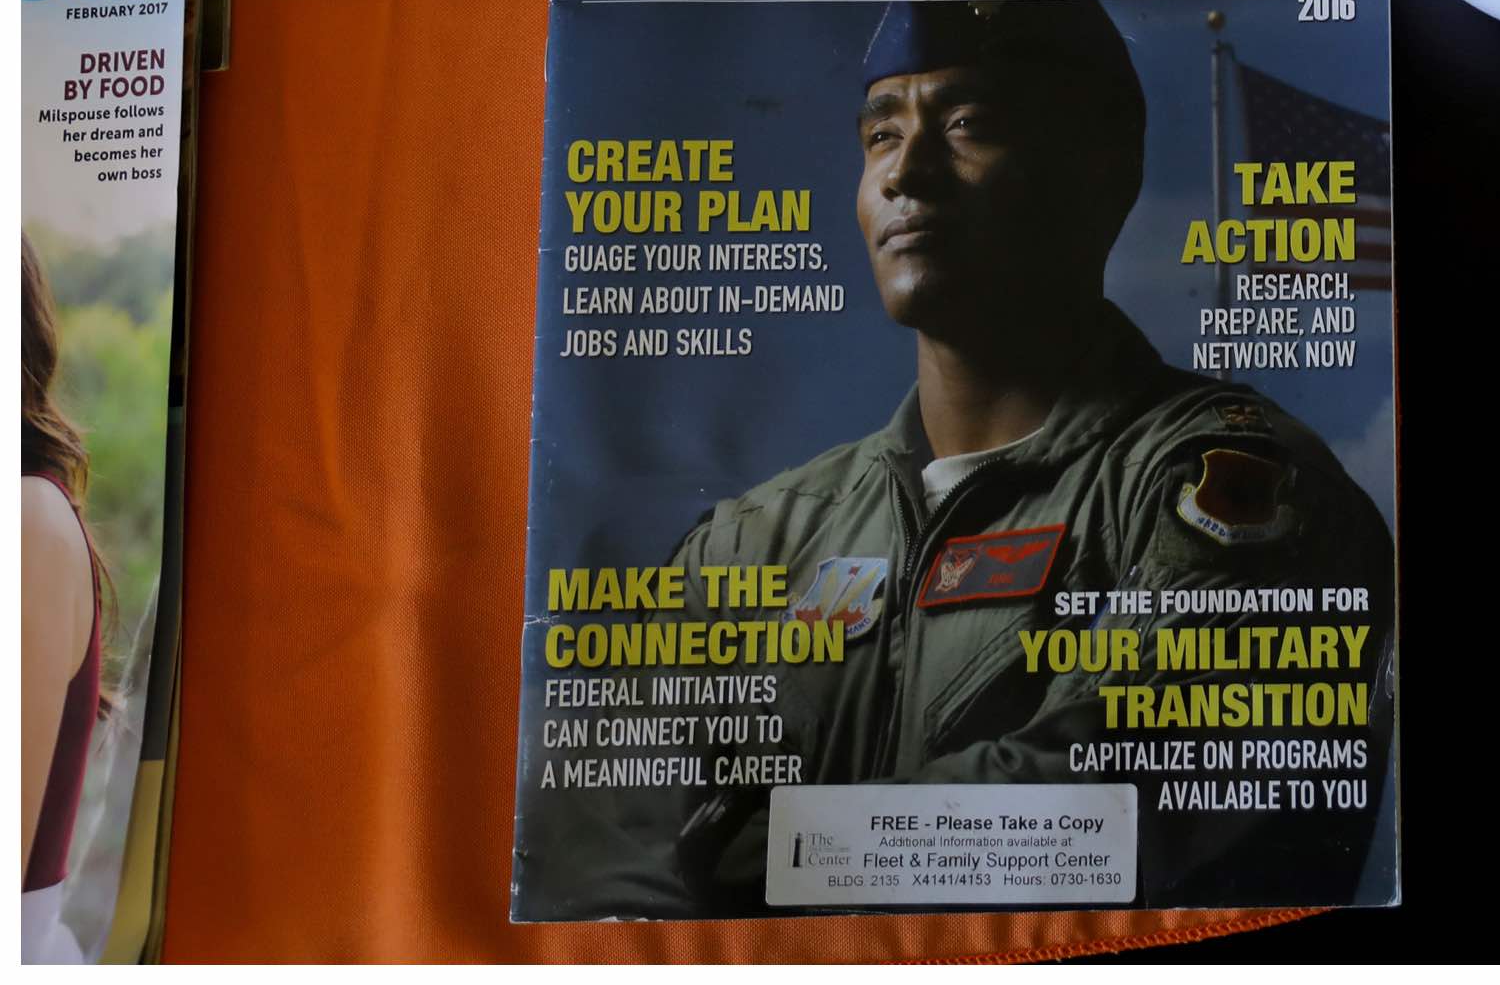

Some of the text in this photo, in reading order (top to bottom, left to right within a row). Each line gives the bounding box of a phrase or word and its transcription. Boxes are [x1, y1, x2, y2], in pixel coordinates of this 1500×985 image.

[66, 2, 168, 19] FEBRUARY 2017
[80, 48, 165, 74] DRIVEN
[64, 75, 165, 100] BY FOOD
[39, 103, 164, 124] Milspouse follows
[567, 139, 734, 183] CREATE
[1234, 161, 1356, 205] TAKE
[565, 189, 811, 233] YOUR PLAN
[1181, 218, 1356, 263] ACTION
[565, 243, 828, 272] GUAGE YOUR INTERESTS,
[1236, 273, 1355, 301] RESEARCH,
[548, 565, 788, 611] MAKE THE
[545, 620, 844, 668] CONNECTION
[1018, 625, 1371, 673] YOUR MILITARY
[545, 675, 777, 707] FEDERAL INITIATIVES
[1099, 683, 1369, 729] TRANSITION
[871, 815, 1104, 834] FREE Please Take a Copy
[879, 836, 1072, 848] Additional Information available at
[863, 852, 1110, 871] Fleet & Family Support Center
[871, 872, 1121, 887] 2135 X4141/4153 Hours: 0730-1630
